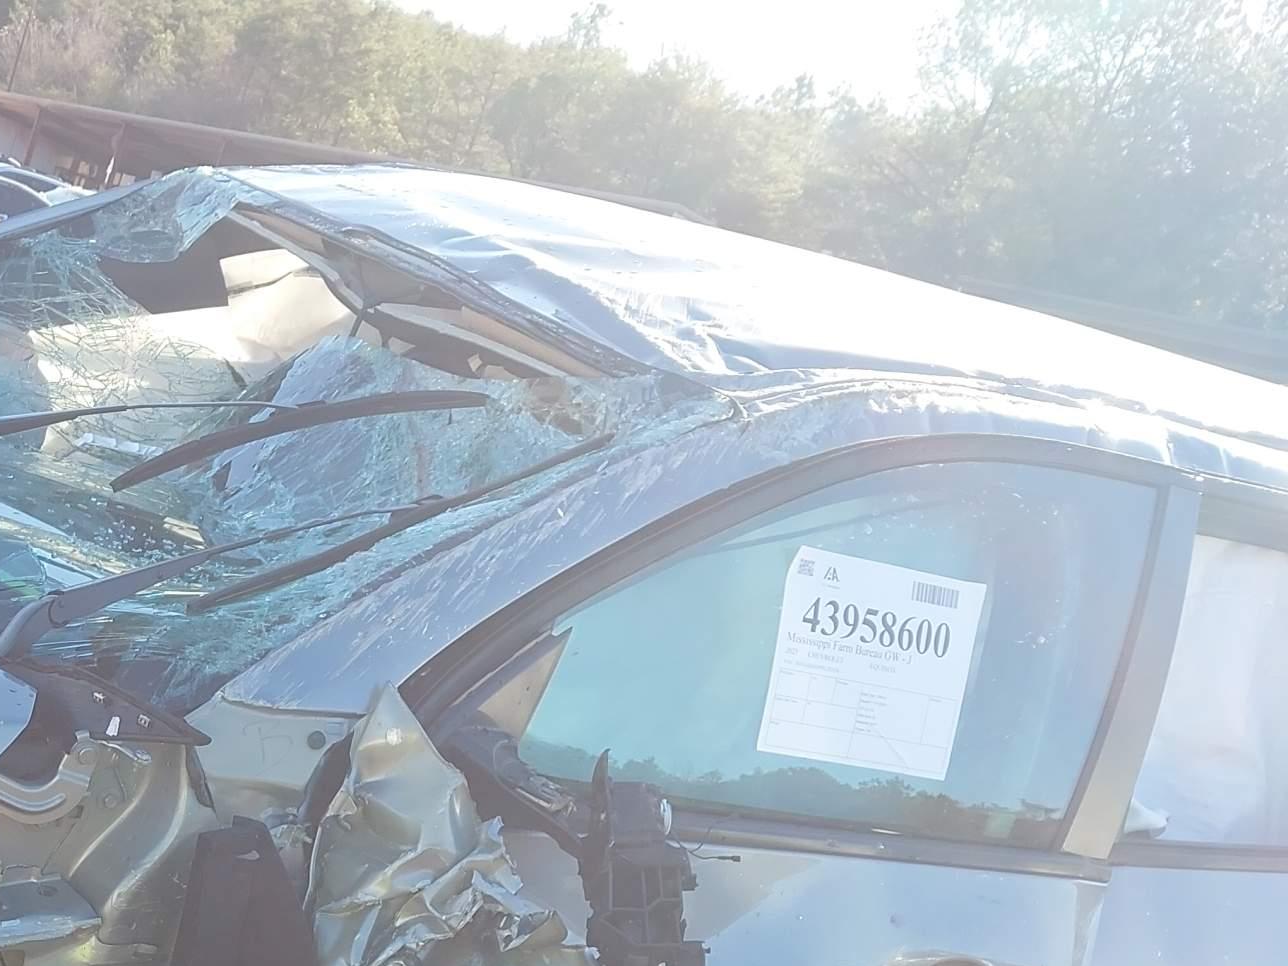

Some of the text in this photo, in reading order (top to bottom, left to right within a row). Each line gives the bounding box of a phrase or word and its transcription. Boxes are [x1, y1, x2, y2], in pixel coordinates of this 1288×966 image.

[786, 631, 832, 650] Mississippi
[833, 640, 854, 654] Farm
[855, 645, 883, 660] Bureau
[802, 597, 951, 658] 43958600
